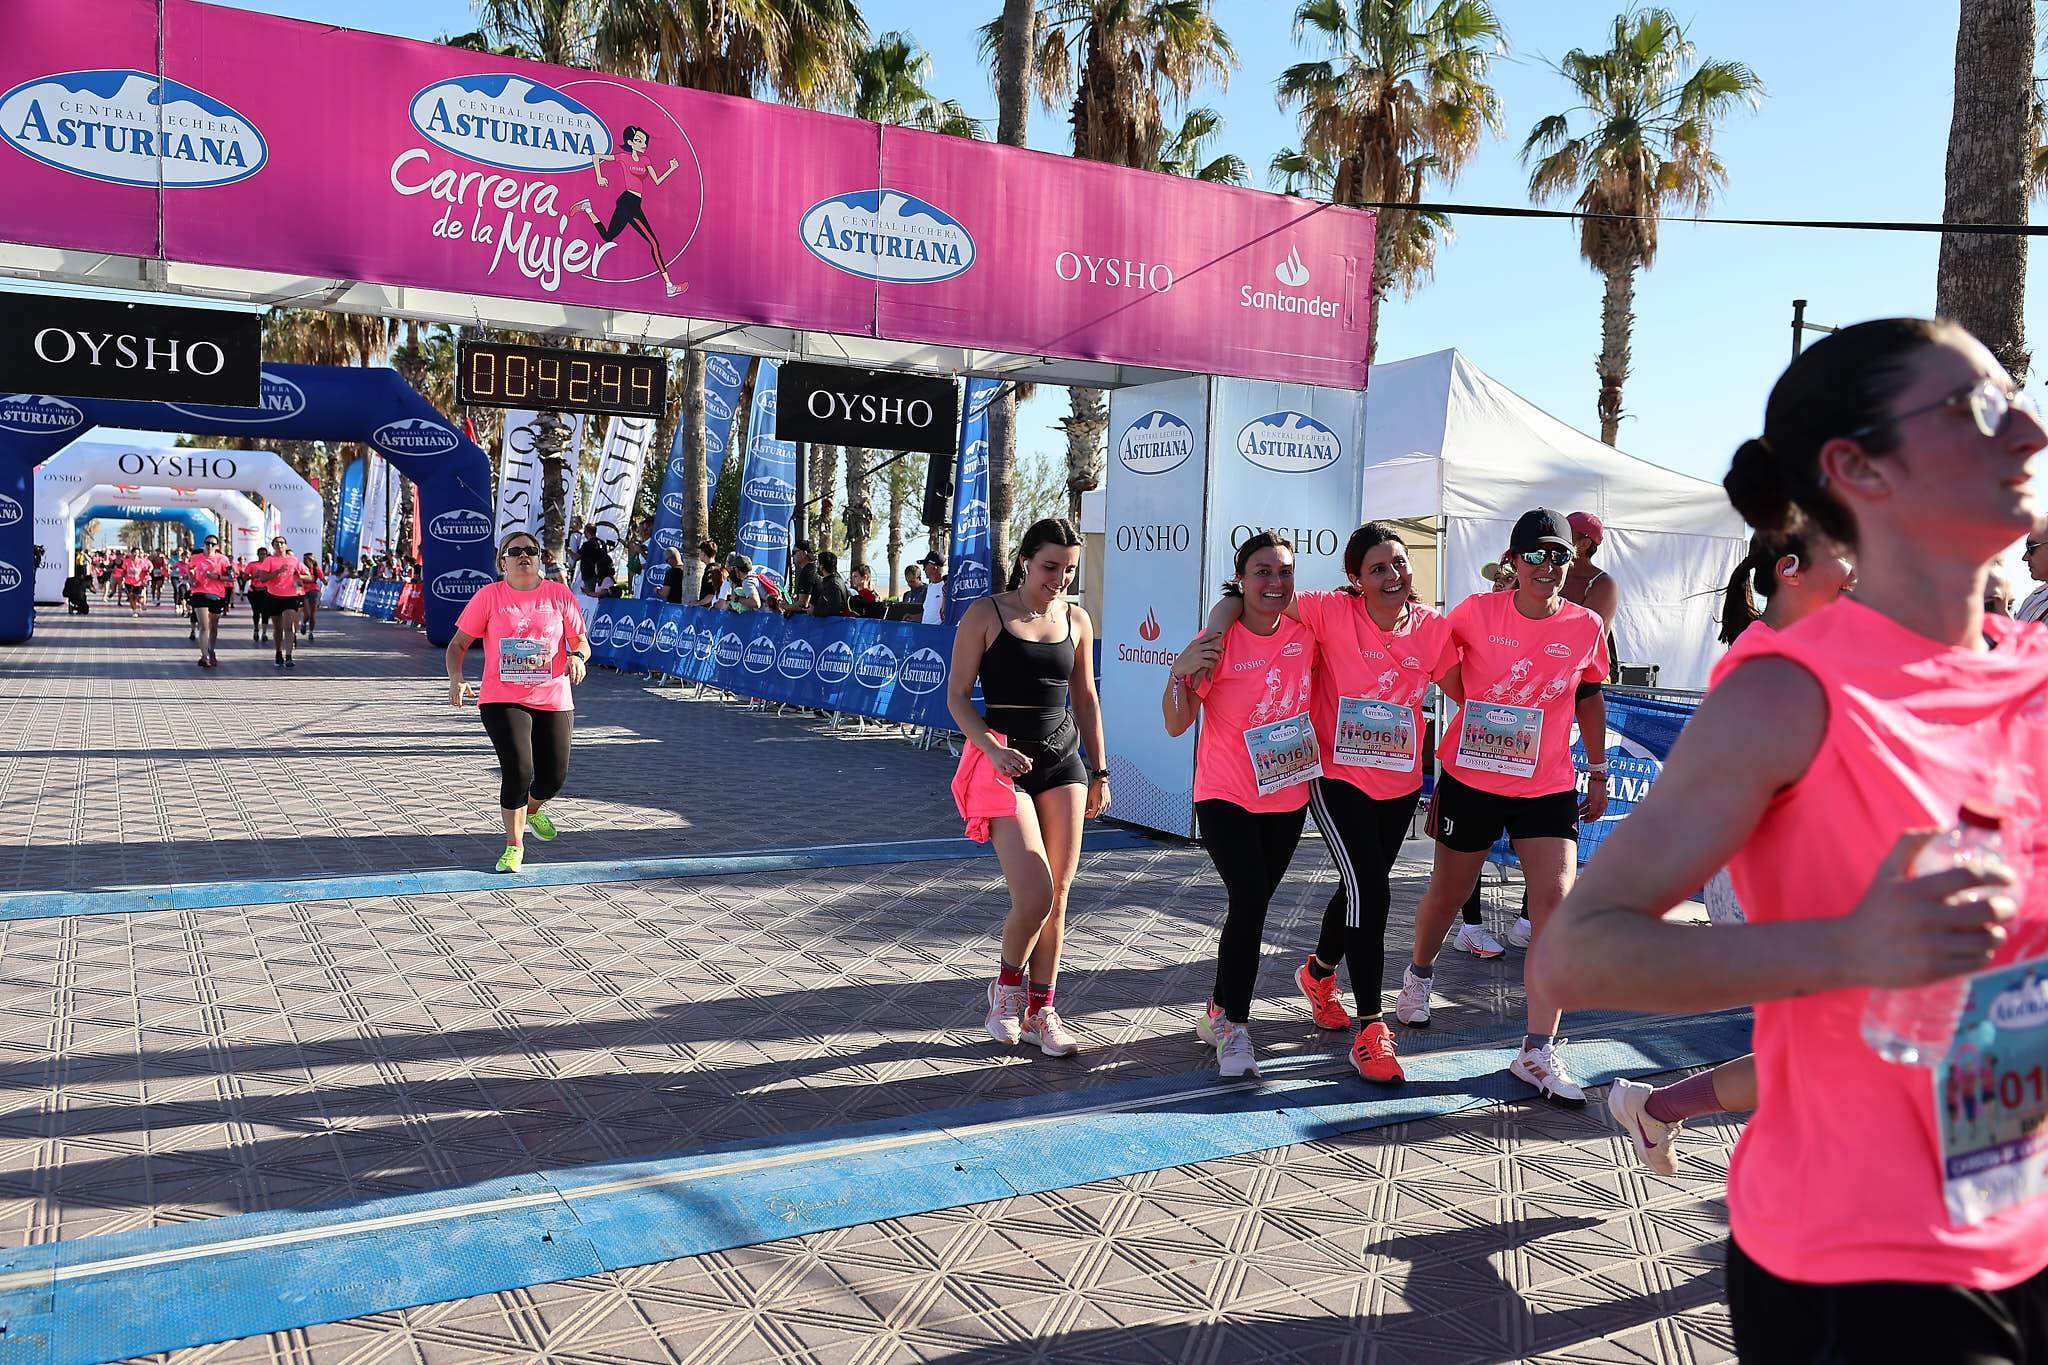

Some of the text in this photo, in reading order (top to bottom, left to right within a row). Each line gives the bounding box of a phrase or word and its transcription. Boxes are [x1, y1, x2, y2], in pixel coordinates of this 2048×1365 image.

[60, 101, 146, 122] CENTRAL
[458, 99, 592, 129] CENTRAL LECHERA
[16, 99, 248, 168] ASTURIANA
[426, 97, 596, 156] ASTURIANA
[390, 148, 560, 216] Carrera
[842, 215, 957, 239] CENTRAL LECHERA
[432, 207, 618, 291] de la Mujer
[814, 215, 962, 266] ASTURIANA
[1055, 252, 1173, 293] OYSHO
[1240, 285, 1340, 318] Santander
[34, 327, 225, 376] OYSHO
[473, 352, 652, 406] 00:42:44
[706, 399, 731, 418] URIANA
[808, 389, 933, 428] OYSHO
[0, 410, 76, 426] STURIANA
[381, 431, 453, 447] ASTURIANA
[1261, 431, 1331, 442] CENTRAL LECHERA
[753, 442, 797, 459] ASTURIAN
[1123, 437, 1188, 461] ASTURIANA
[1244, 431, 1333, 461] ASTURIANA
[118, 453, 237, 480] OYSHO
[44, 475, 82, 483] OYSHO
[269, 483, 304, 491] OYSHO
[501, 426, 537, 533] YSHO
[34, 517, 63, 526] YSHO
[433, 519, 490, 535] ASTURIANA
[286, 527, 318, 535] OYSHO
[1116, 524, 1190, 552] OYSHO
[658, 533, 684, 549] ASTURI
[1231, 525, 1338, 556] OHO
[436, 581, 485, 594] ASTURIA
[1488, 634, 1520, 649] OYSHO
[516, 656, 536, 665] 016
[744, 652, 773, 665] ASTURIANA
[781, 653, 811, 671] ASTURIANA
[1358, 649, 1384, 660] YSHO
[818, 656, 850, 674] ASTURIANA
[857, 663, 893, 680] ASTURIANA
[1234, 659, 1266, 672] OYSHO
[901, 668, 941, 684] ASTURIANA
[1362, 729, 1392, 743] 016
[1485, 733, 1514, 748] 016
[1277, 747, 1303, 765] 016
[1609, 759, 1652, 775] CHERA
